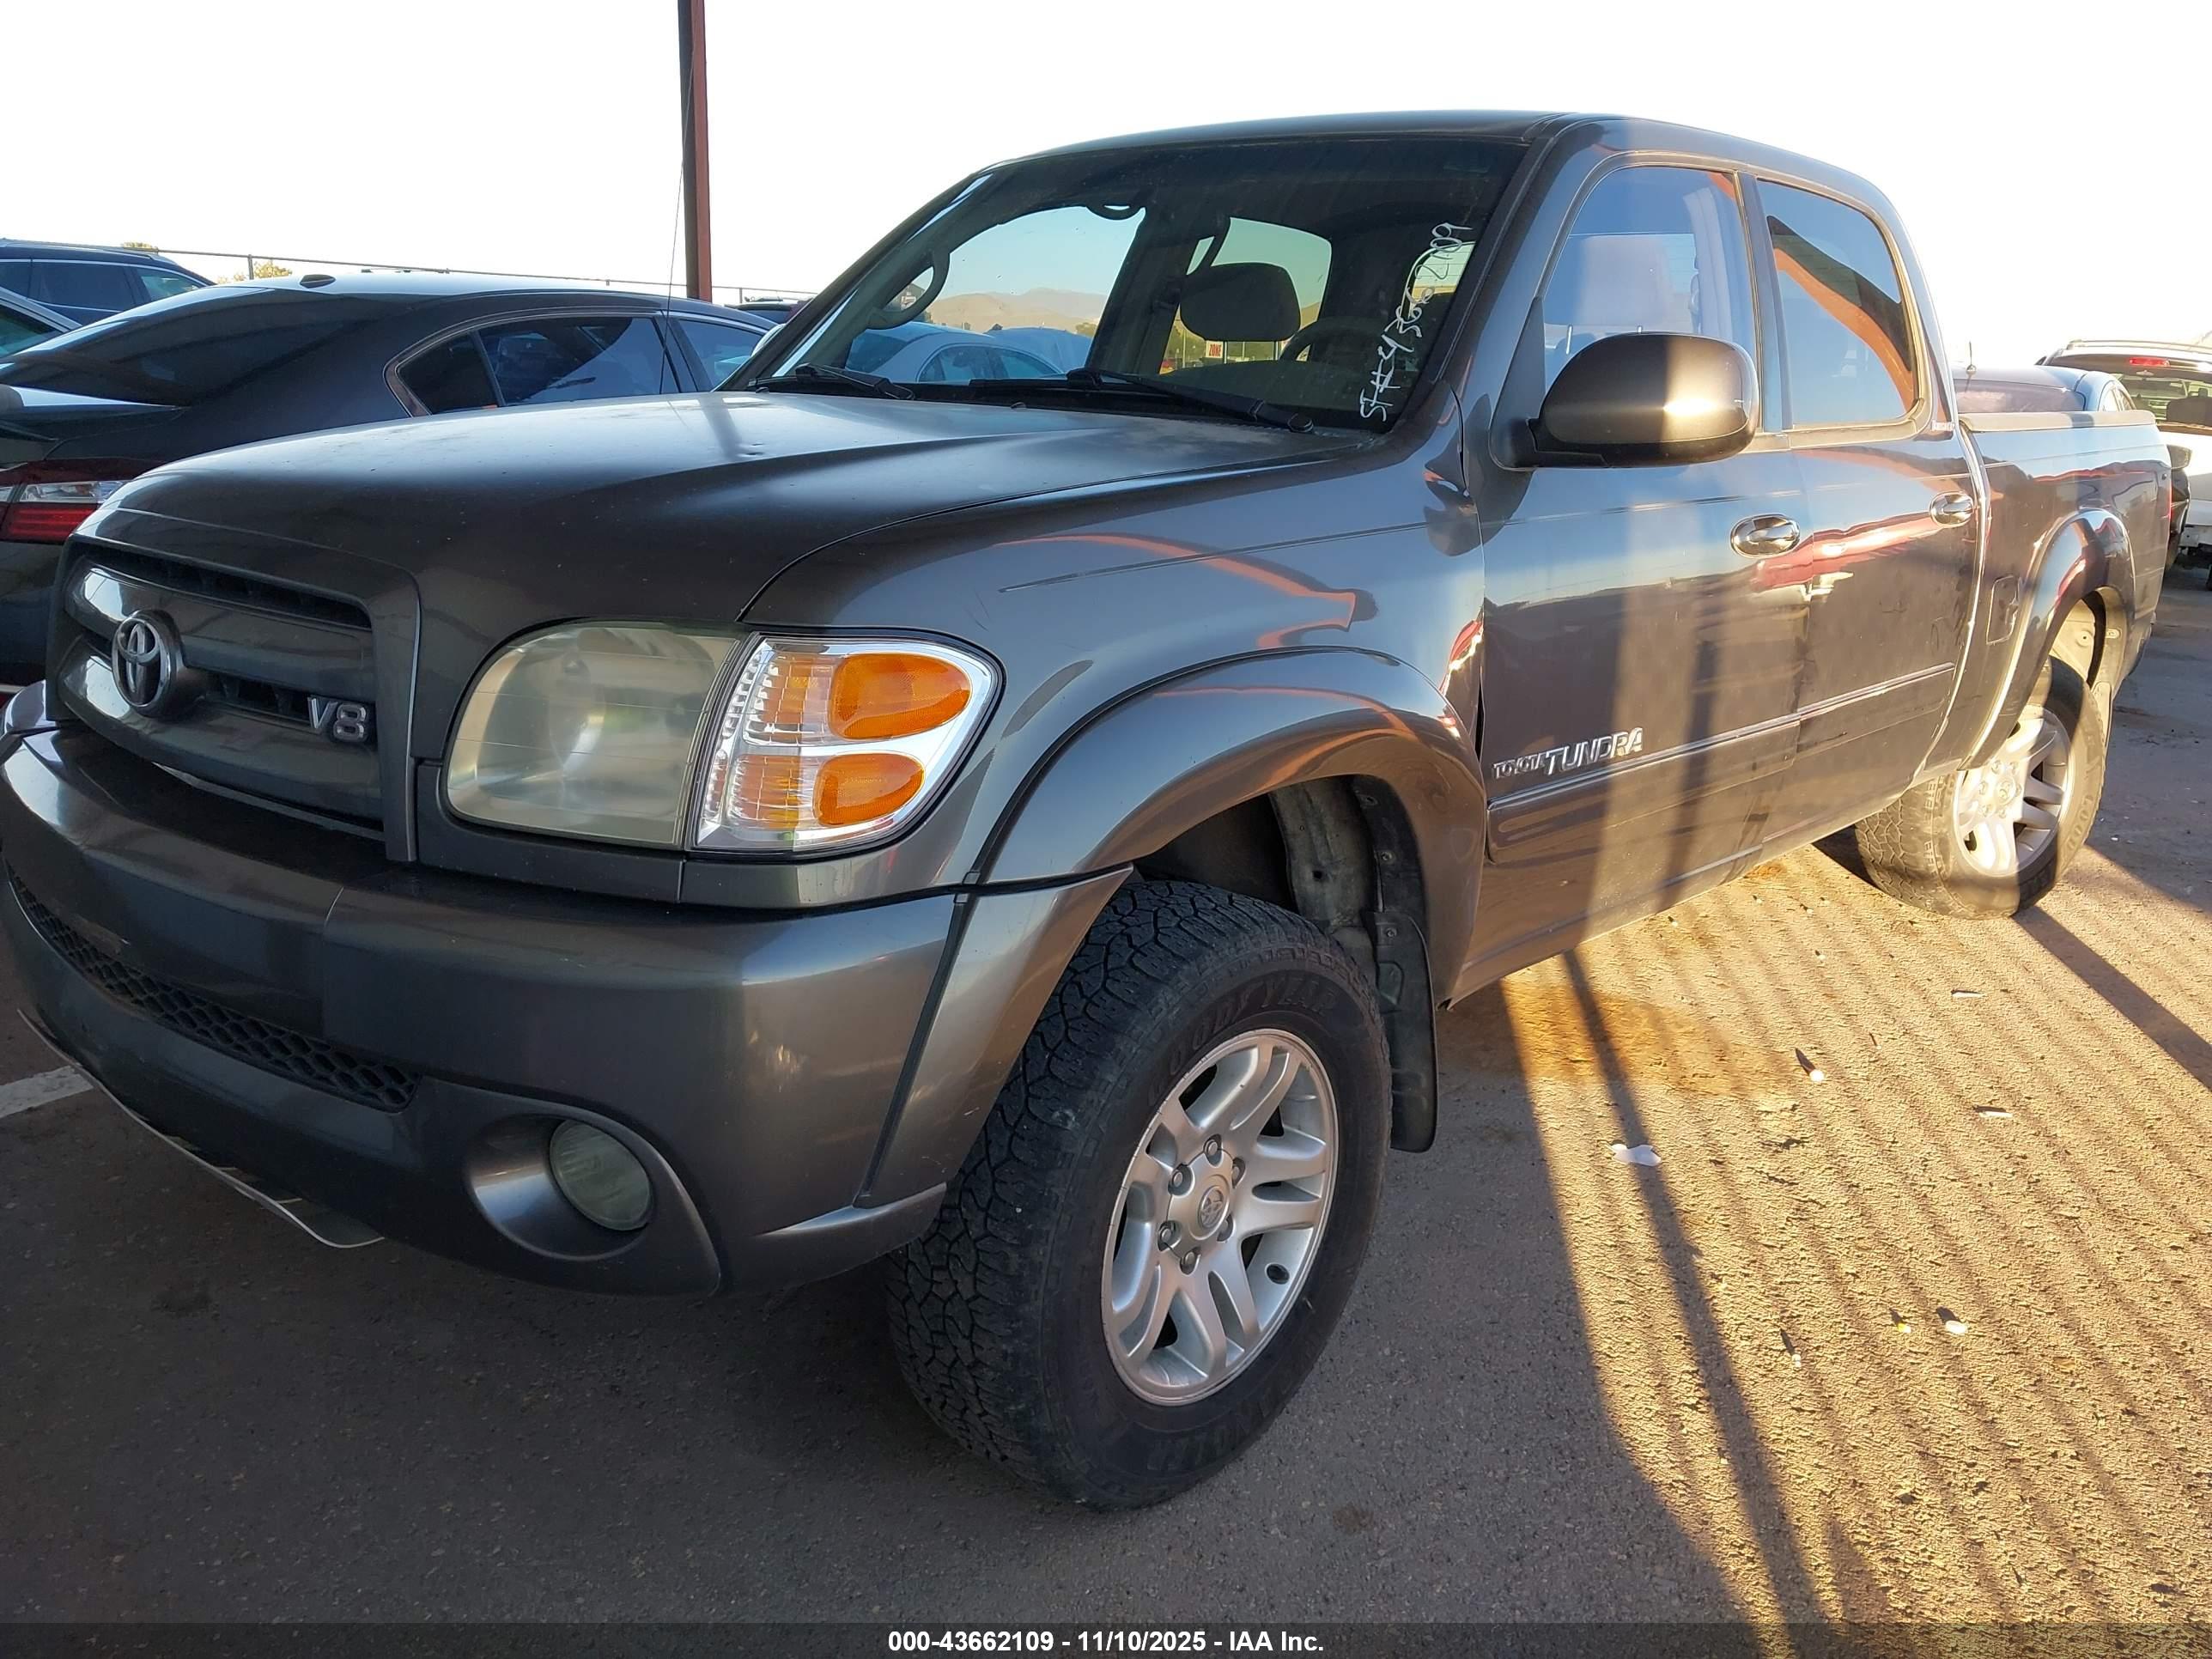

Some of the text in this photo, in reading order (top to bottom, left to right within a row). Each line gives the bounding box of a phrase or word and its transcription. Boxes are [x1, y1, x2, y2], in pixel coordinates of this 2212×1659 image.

[307, 695, 368, 740] V8
[1492, 727, 1644, 779] TOYOTA TUNDRA
